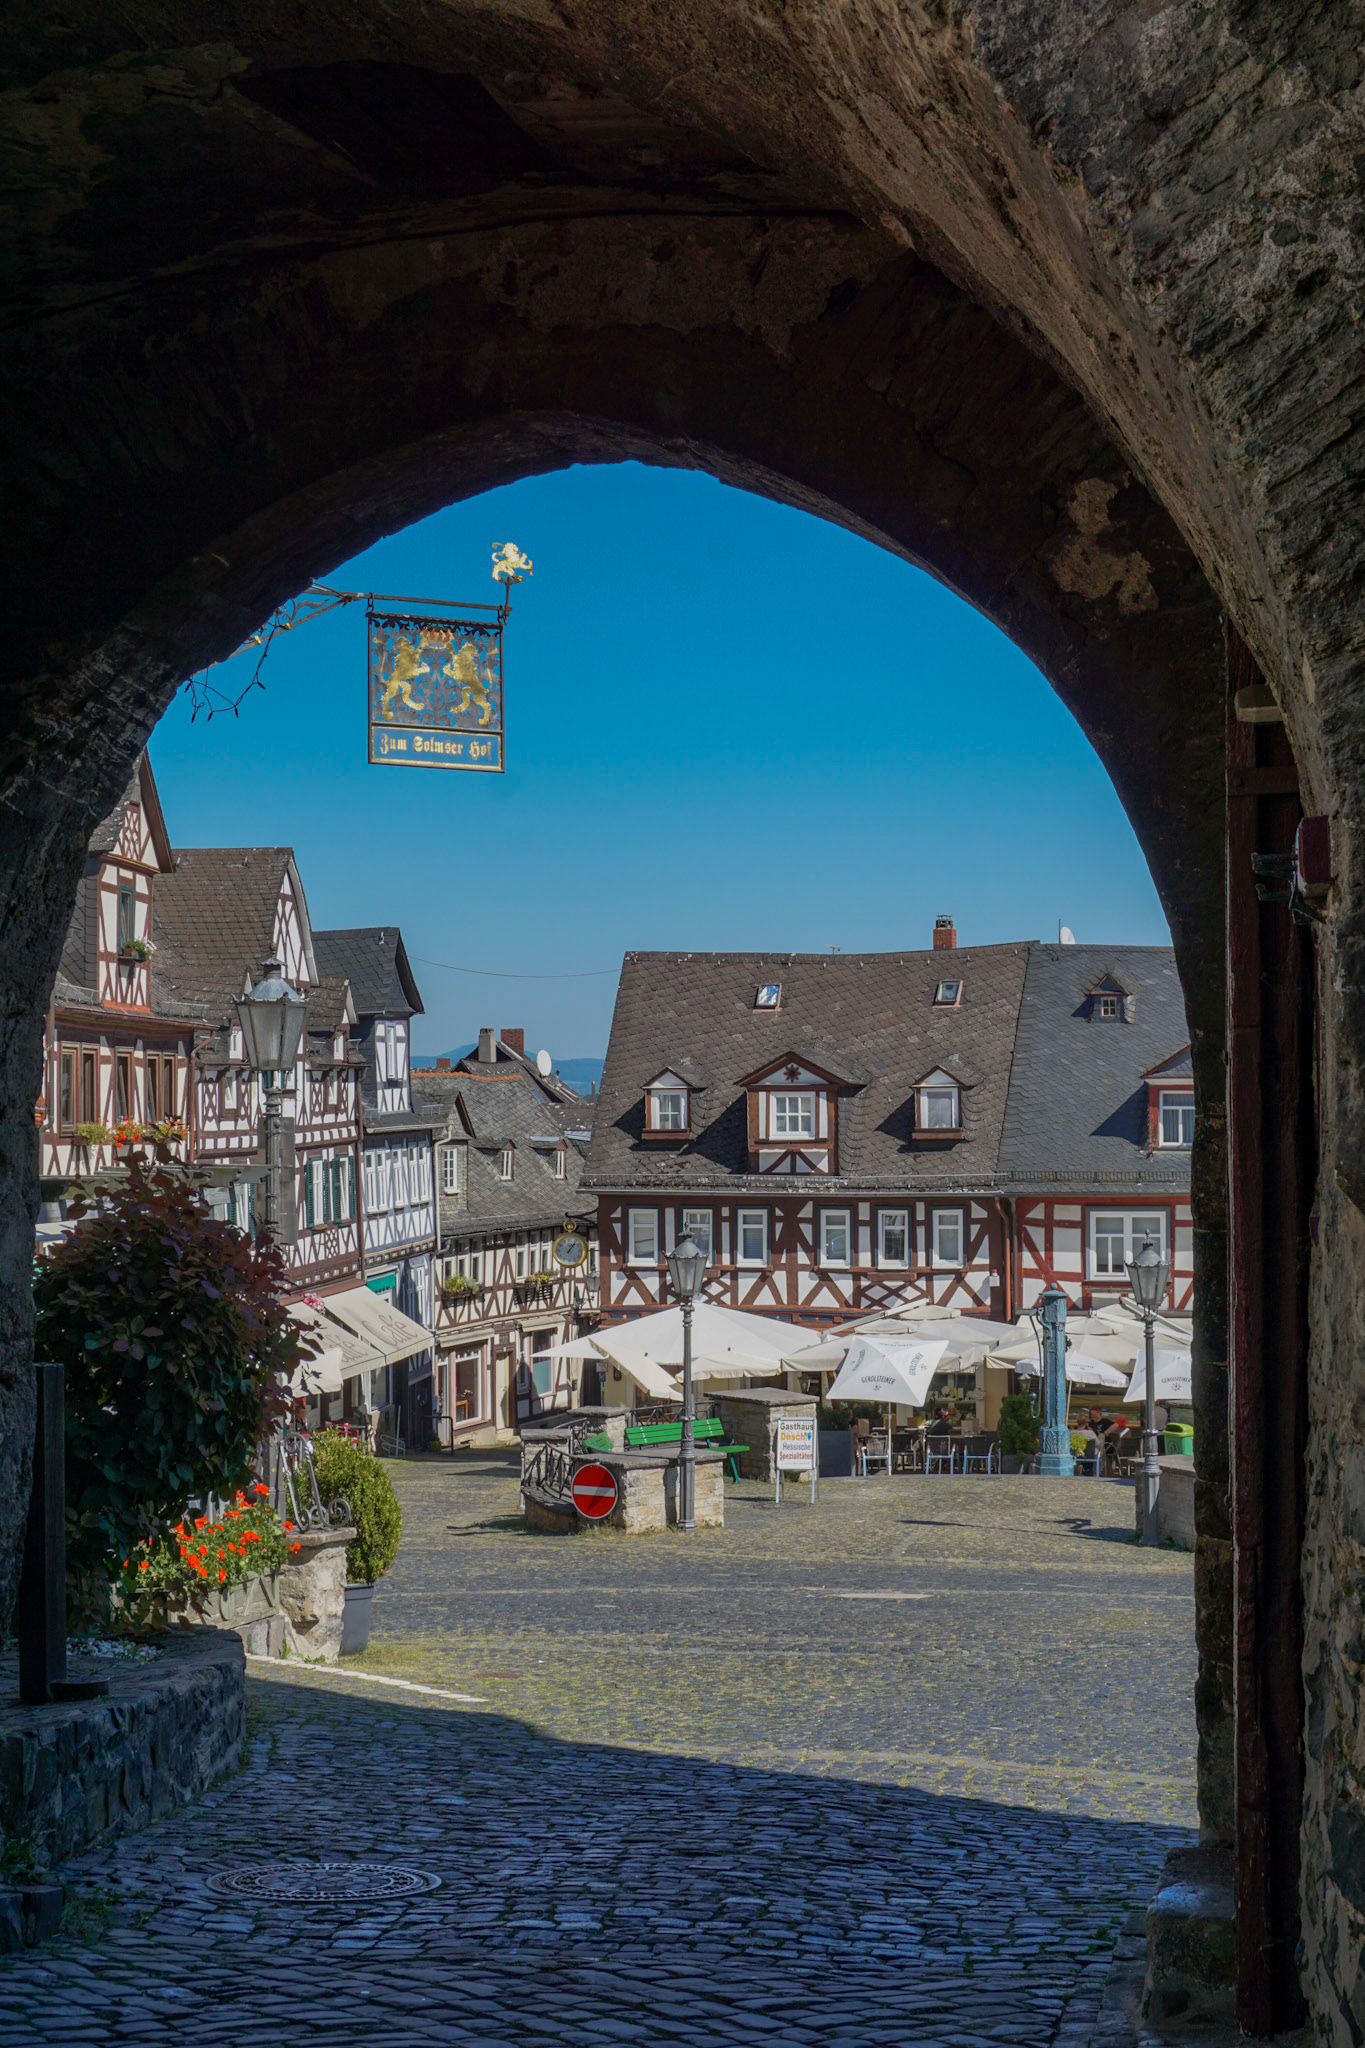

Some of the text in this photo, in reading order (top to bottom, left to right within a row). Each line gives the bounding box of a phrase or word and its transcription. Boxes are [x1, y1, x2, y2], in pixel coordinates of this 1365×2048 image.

[380, 733, 492, 761] Zum Solmser Hof
[362, 1314, 418, 1347] Café
[861, 1375, 896, 1385] GEROLSTEINER
[780, 1422, 814, 1431] Gasthaus
[783, 1442, 811, 1451] Hessische
